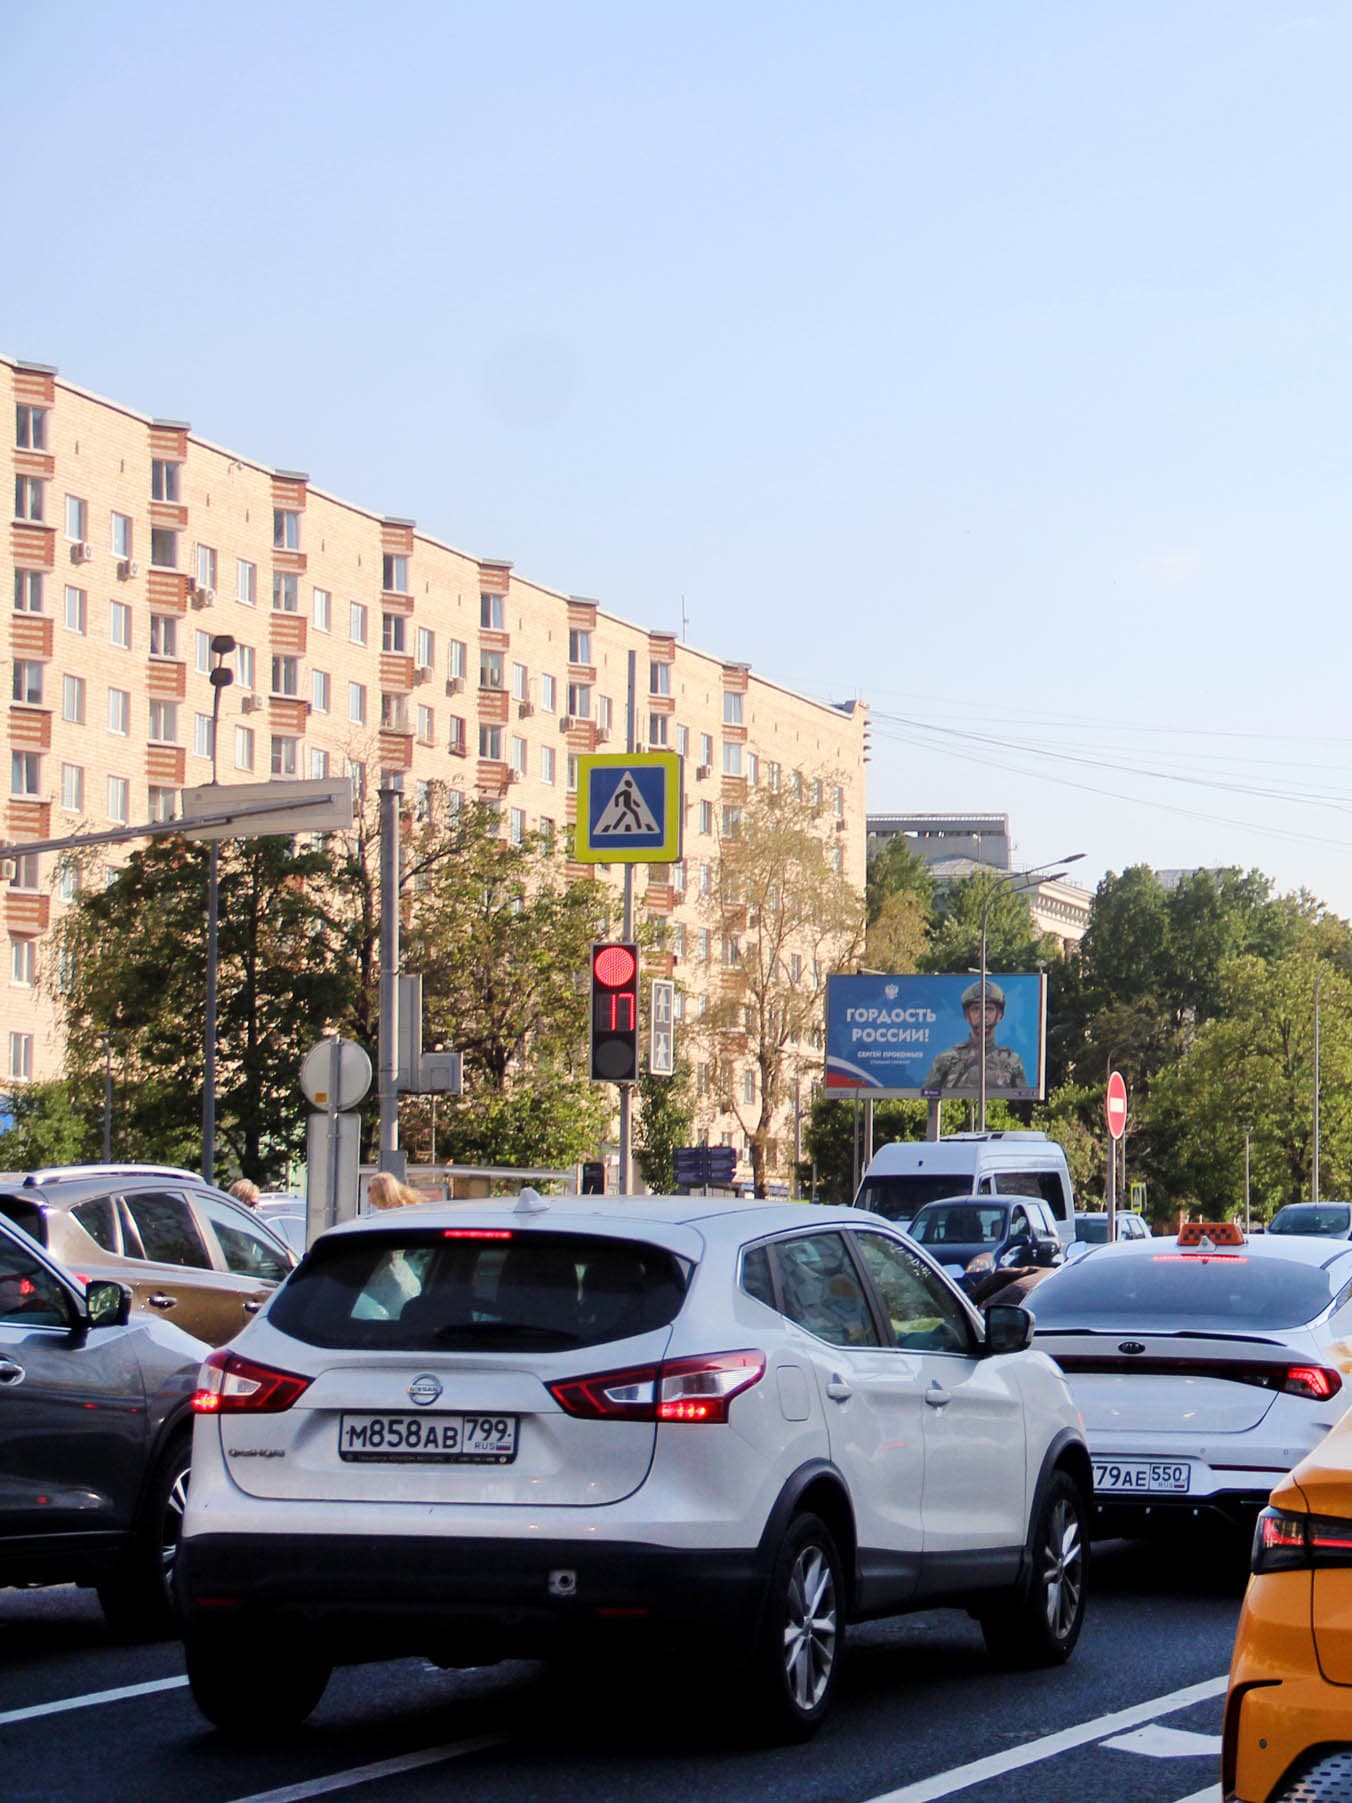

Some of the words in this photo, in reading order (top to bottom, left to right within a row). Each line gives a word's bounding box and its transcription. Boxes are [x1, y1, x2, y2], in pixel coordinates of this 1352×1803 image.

[846, 1008, 937, 1024] ГОРДОСТЬ
[852, 1028, 929, 1042] РОССИИ!
[350, 1419, 458, 1449] М858АВ
[466, 1419, 507, 1442] 799
[474, 1442, 495, 1450] RUS
[1092, 1466, 1147, 1487] 79АЕ
[1151, 1466, 1182, 1482] 550
